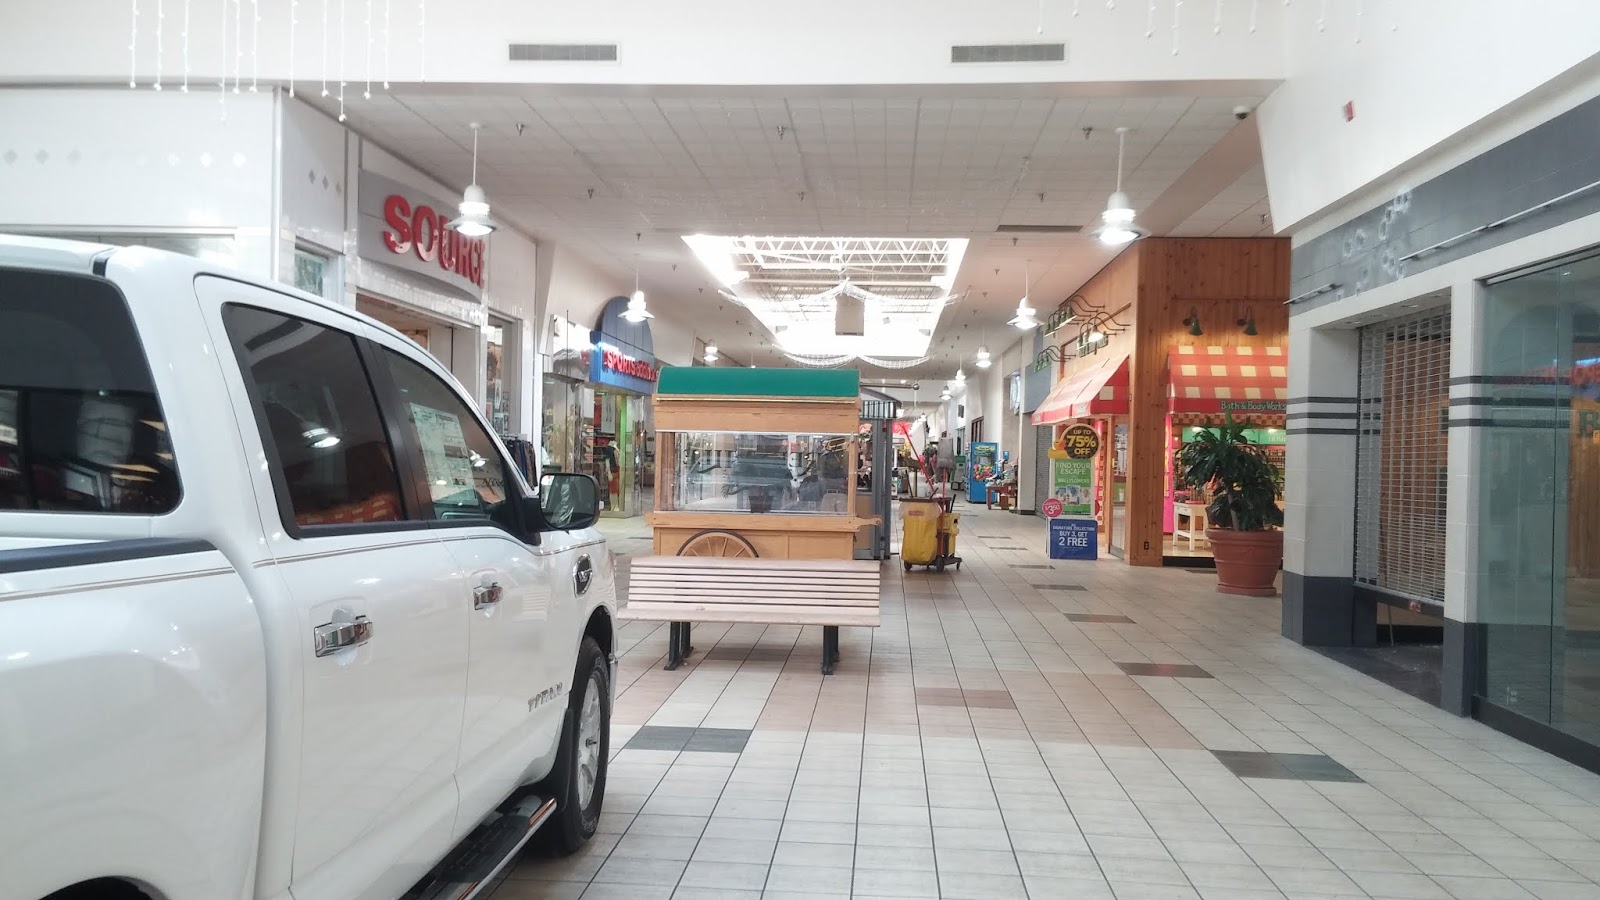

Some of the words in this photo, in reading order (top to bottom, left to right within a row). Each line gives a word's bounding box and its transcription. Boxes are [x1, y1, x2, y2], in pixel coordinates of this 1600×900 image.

[604, 350, 636, 376] SPORTS
[1220, 401, 1240, 411] Bath
[1240, 402, 1247, 410] &
[1247, 401, 1266, 411] Body
[1265, 401, 1287, 411] Works
[1066, 435, 1097, 448] 75%
[1058, 537, 1066, 546] 2
[1067, 537, 1088, 547] FREE
[527, 681, 563, 713] TITAN
